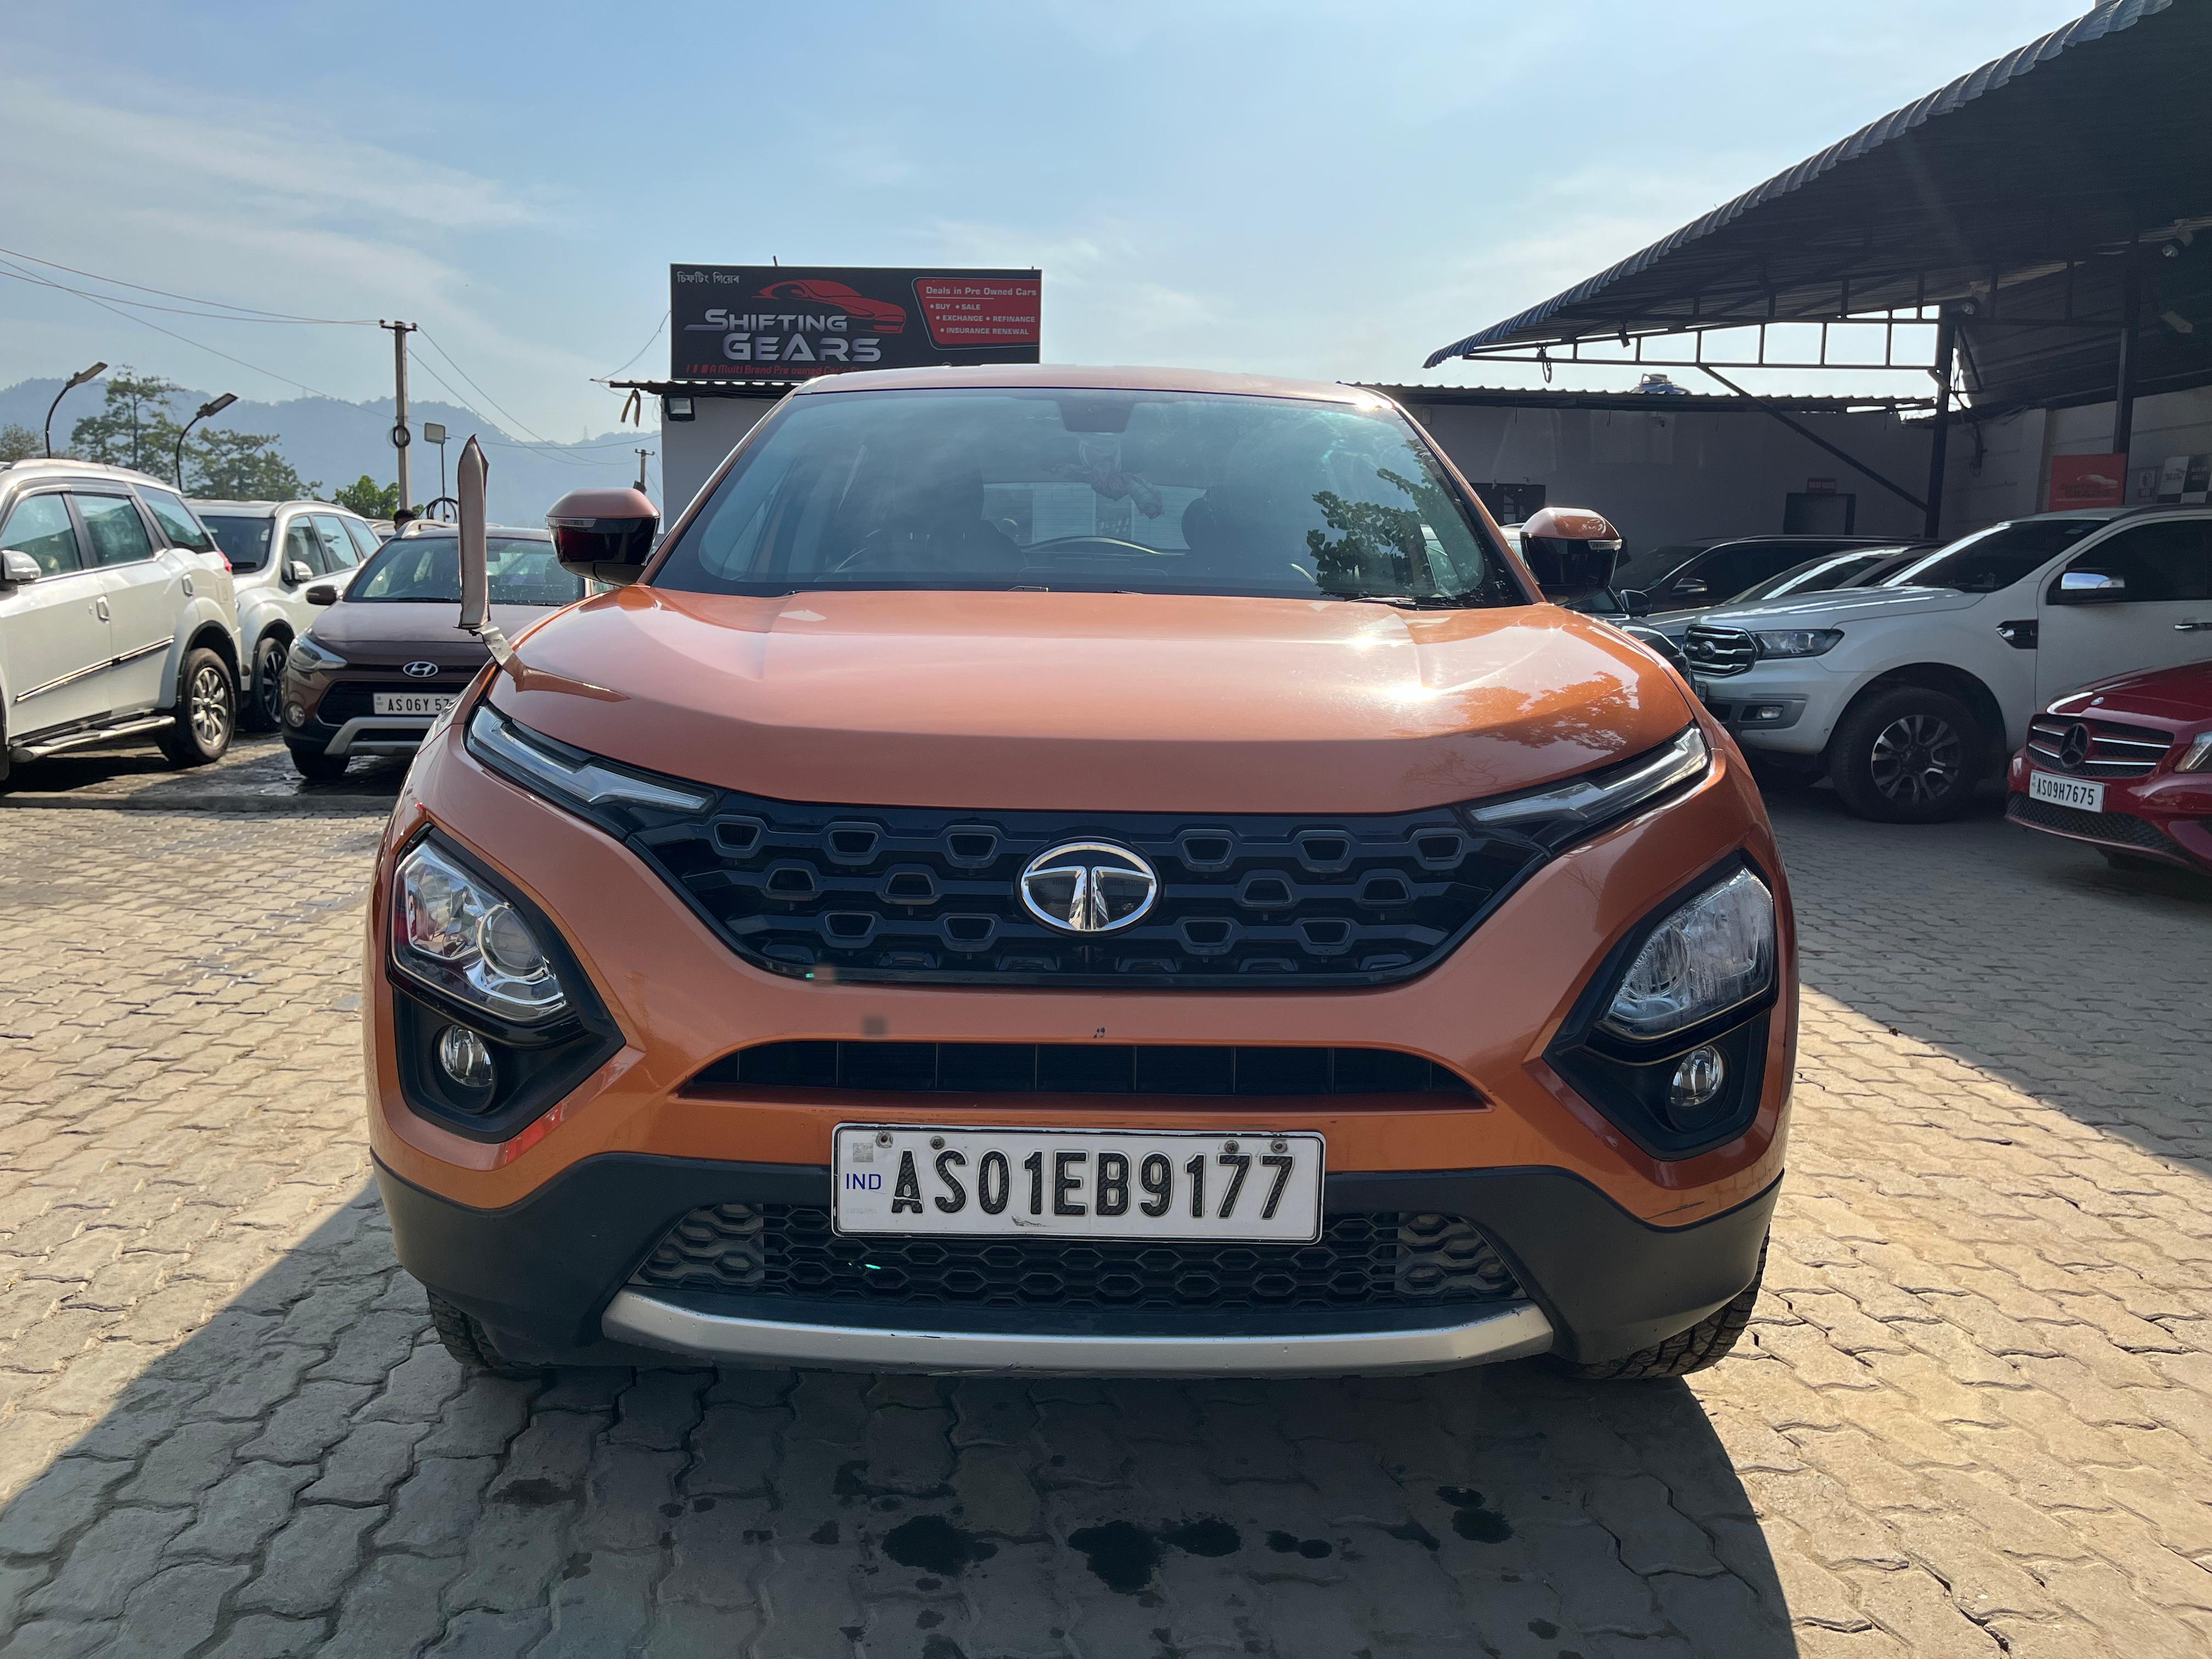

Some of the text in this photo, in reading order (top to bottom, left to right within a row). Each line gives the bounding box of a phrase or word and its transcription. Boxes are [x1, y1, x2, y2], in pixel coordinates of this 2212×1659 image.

[926, 286, 951, 295] Deals
[964, 287, 981, 295] Pre
[983, 287, 1013, 296] Owned
[723, 332, 882, 362] GEARS
[744, 365, 772, 374] Brand
[774, 365, 789, 375] Pre
[791, 366, 823, 375] owned
[388, 698, 429, 712] AS06Y
[2036, 778, 2095, 806] AS09H7675
[846, 1150, 1295, 1218] IND AS01EB9177
